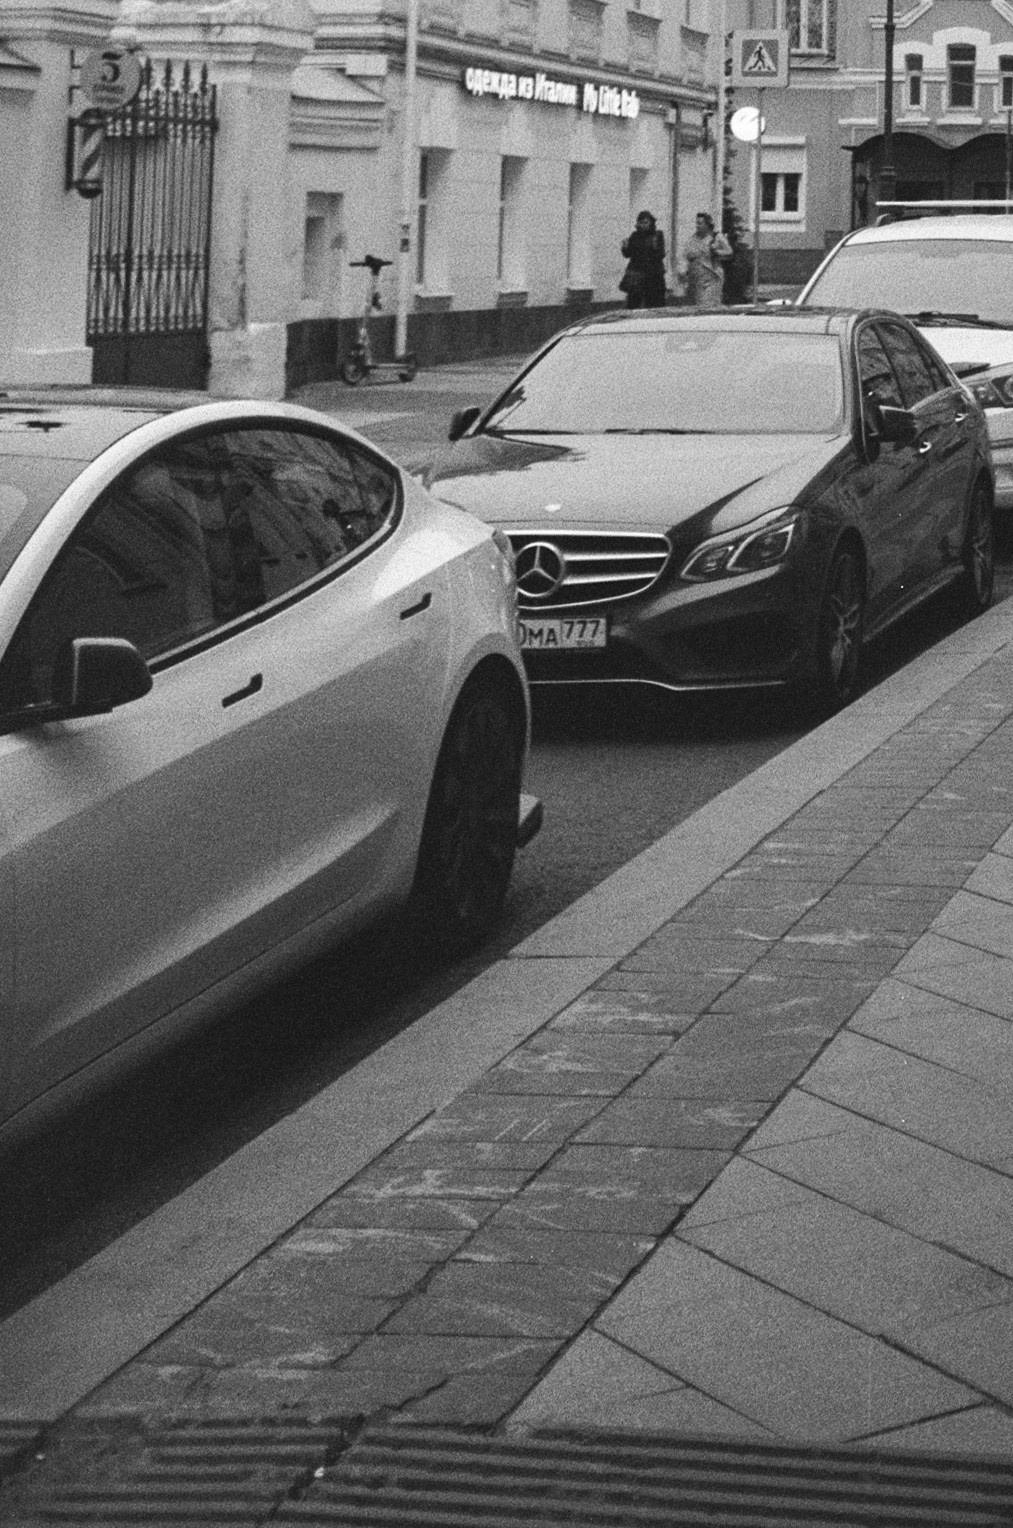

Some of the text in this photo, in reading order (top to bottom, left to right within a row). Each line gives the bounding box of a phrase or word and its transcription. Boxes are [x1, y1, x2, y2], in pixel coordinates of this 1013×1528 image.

[101, 51, 123, 83] 5
[466, 67, 577, 105] одежда из Италии
[583, 83, 598, 113] My
[598, 85, 621, 116] Little
[563, 620, 600, 639] 777
